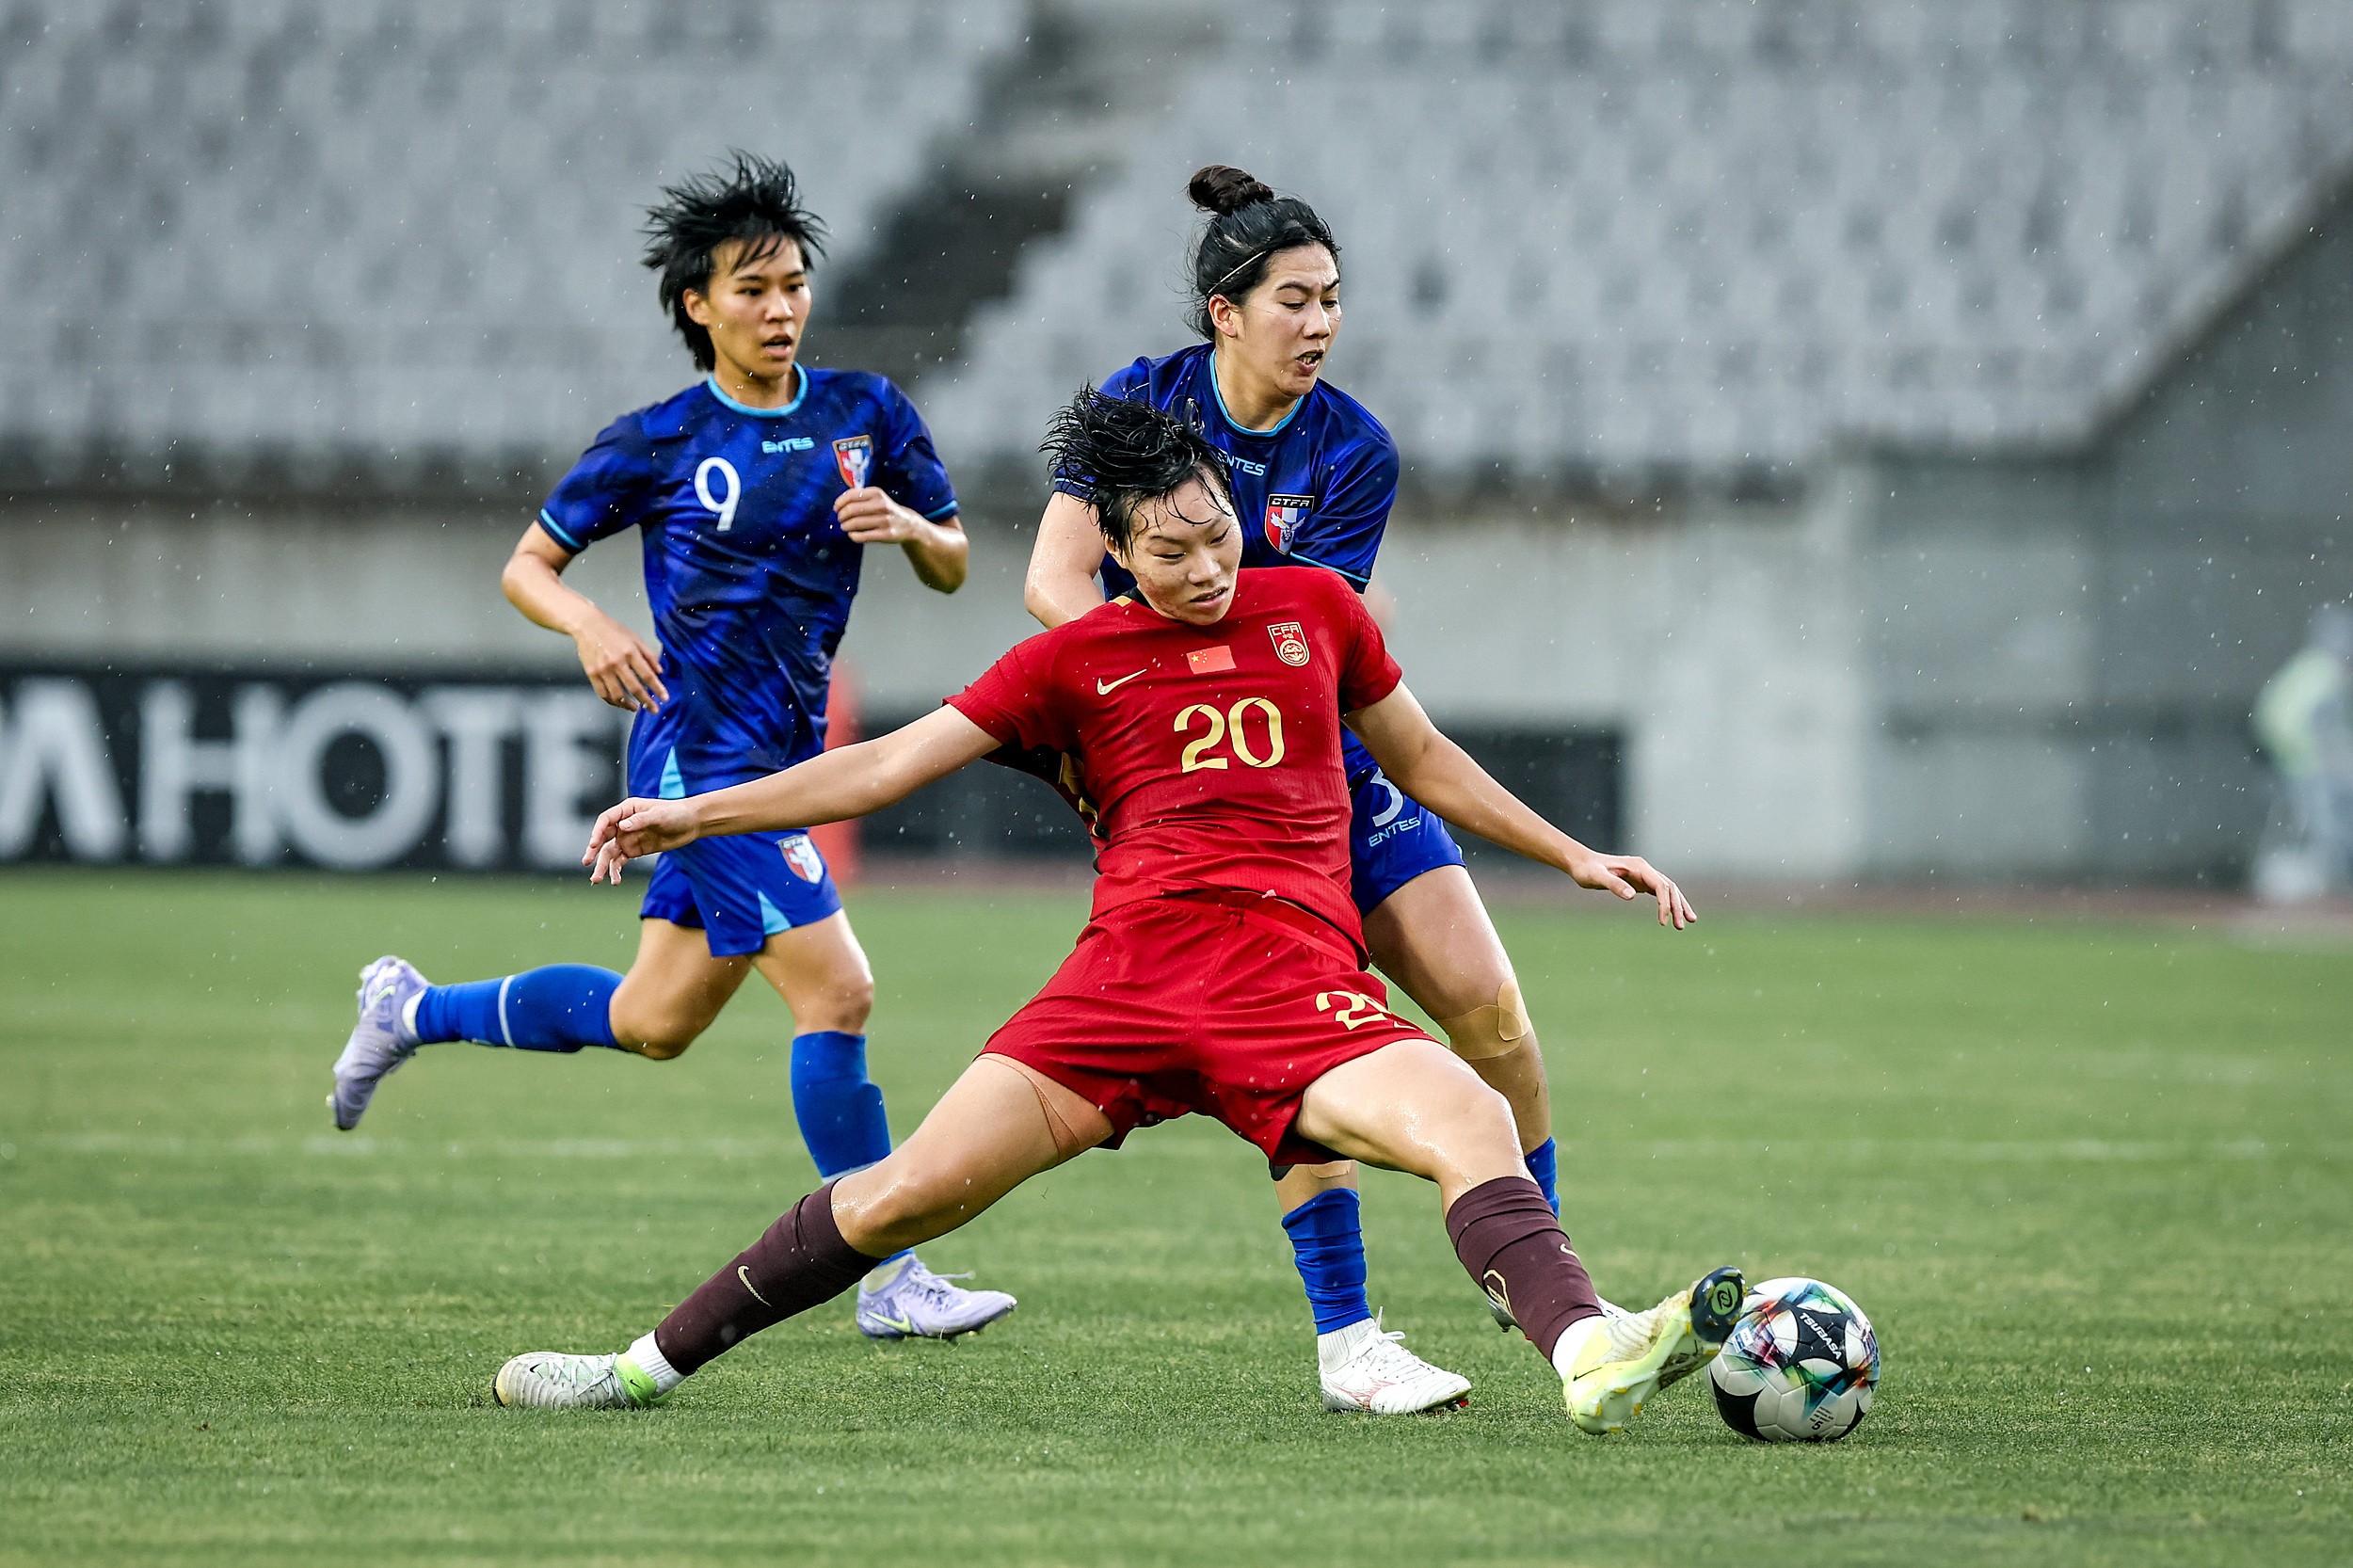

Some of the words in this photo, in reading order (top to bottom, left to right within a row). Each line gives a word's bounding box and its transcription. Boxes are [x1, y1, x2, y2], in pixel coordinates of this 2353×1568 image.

[694, 456, 742, 532] 9
[1271, 498, 1310, 507] CTFA
[1271, 625, 1300, 636] CFA
[1174, 697, 1286, 774] 20
[139, 676, 657, 868] HOTE
[1368, 817, 1421, 848] ENTES
[1800, 1312, 1842, 1360] TSUBASA
